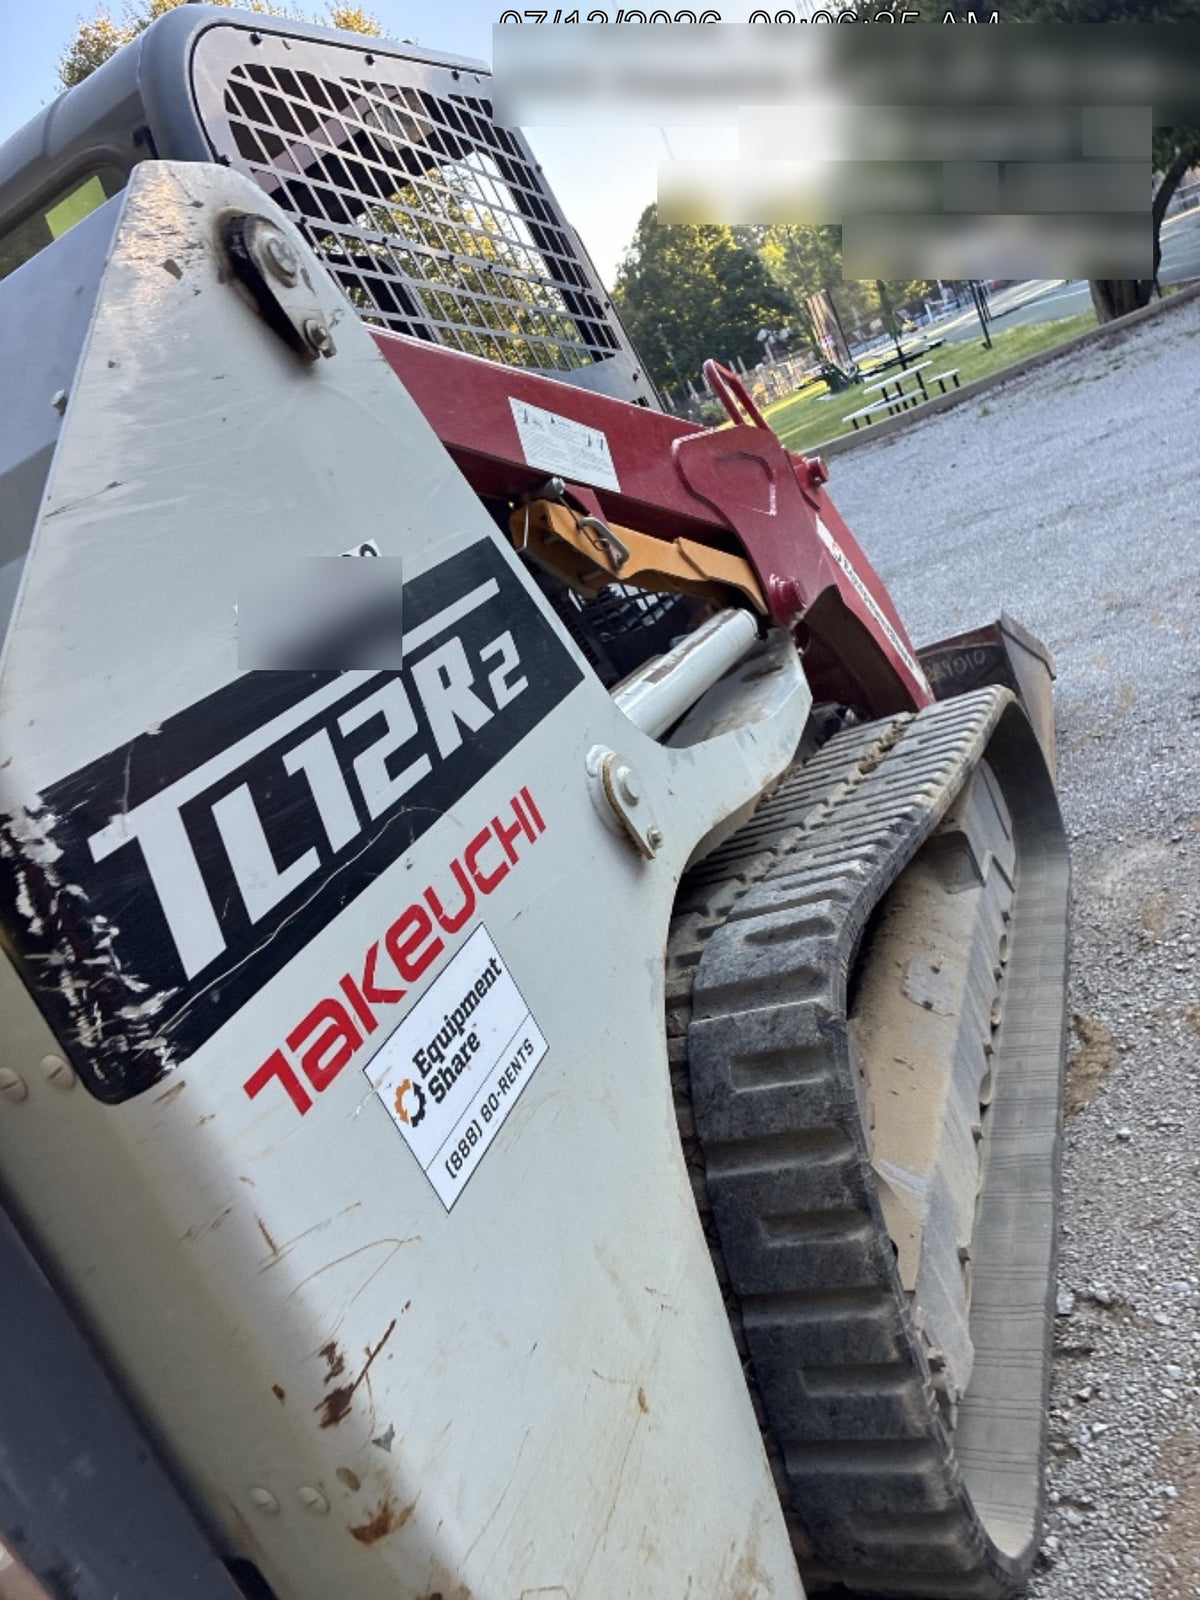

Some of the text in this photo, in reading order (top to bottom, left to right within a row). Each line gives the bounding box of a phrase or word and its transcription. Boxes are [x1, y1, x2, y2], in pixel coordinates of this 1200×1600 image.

[87, 577, 529, 982] TL12R2
[411, 957, 503, 1079] Equipment
[427, 1031, 482, 1104] Share
[445, 1037, 535, 1179] (888) 80-RENTS
